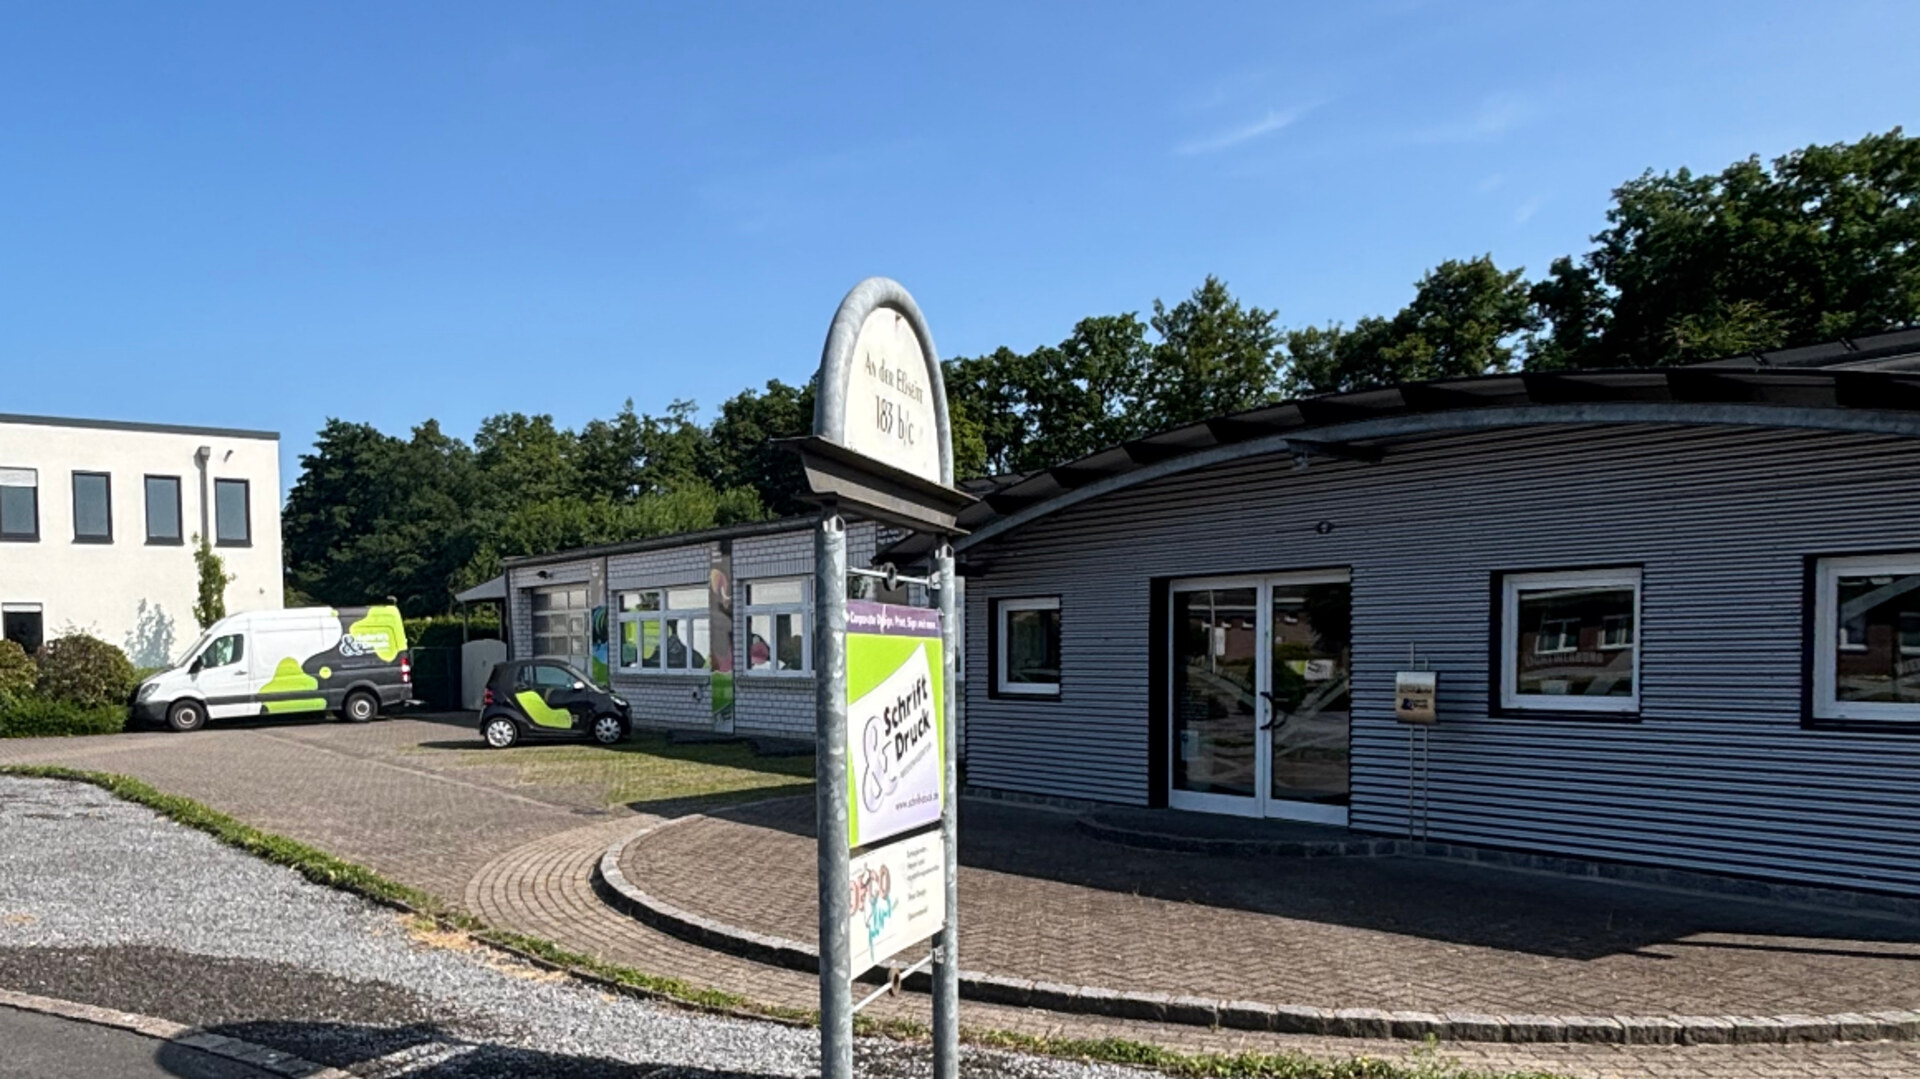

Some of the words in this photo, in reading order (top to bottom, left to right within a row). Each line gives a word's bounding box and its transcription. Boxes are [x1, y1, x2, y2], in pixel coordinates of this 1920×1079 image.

[865, 351, 876, 378] An
[876, 394, 893, 434] 183
[883, 674, 928, 736] Schrift
[894, 708, 931, 761] Druck
